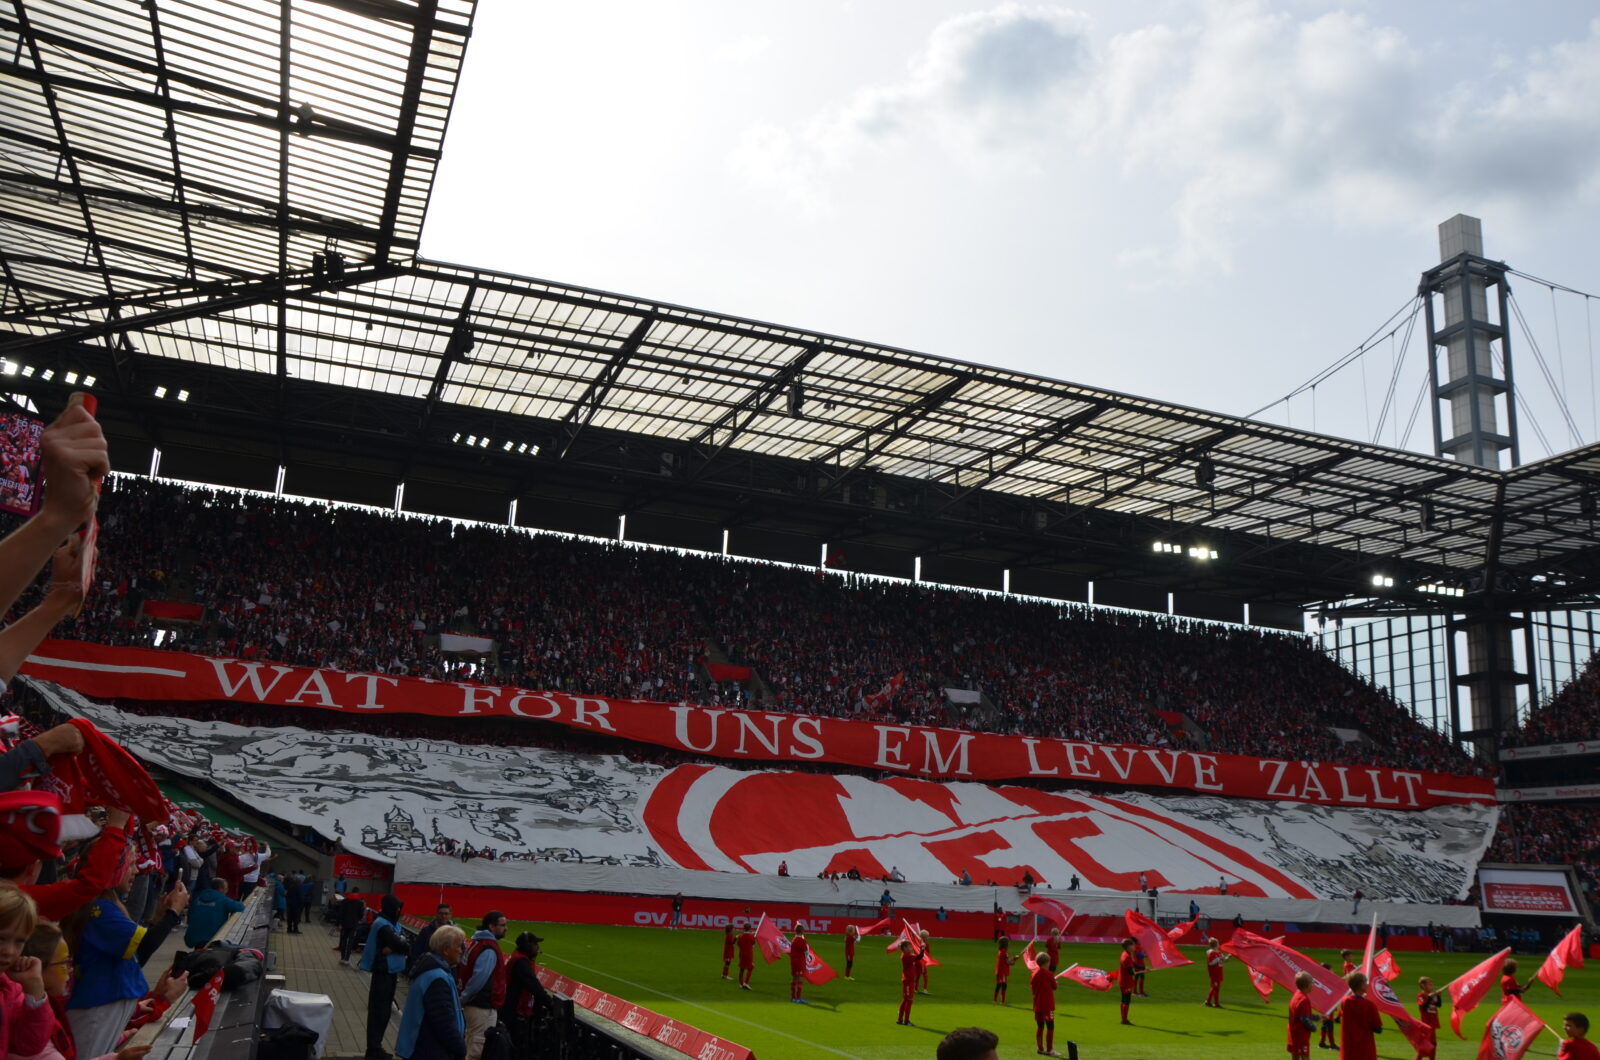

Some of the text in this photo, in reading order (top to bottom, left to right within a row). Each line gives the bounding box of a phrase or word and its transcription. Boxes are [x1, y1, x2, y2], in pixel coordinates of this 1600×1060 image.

[204, 659, 1423, 806] WAT FÖR UNS EM LEVVE ZÄLLT
[303, 735, 394, 747] JAHRE
[405, 741, 508, 761] ULTRAS
[633, 911, 668, 925] OV
[622, 1009, 648, 1031] DERTOUR
[656, 1024, 688, 1049] DERTOUR
